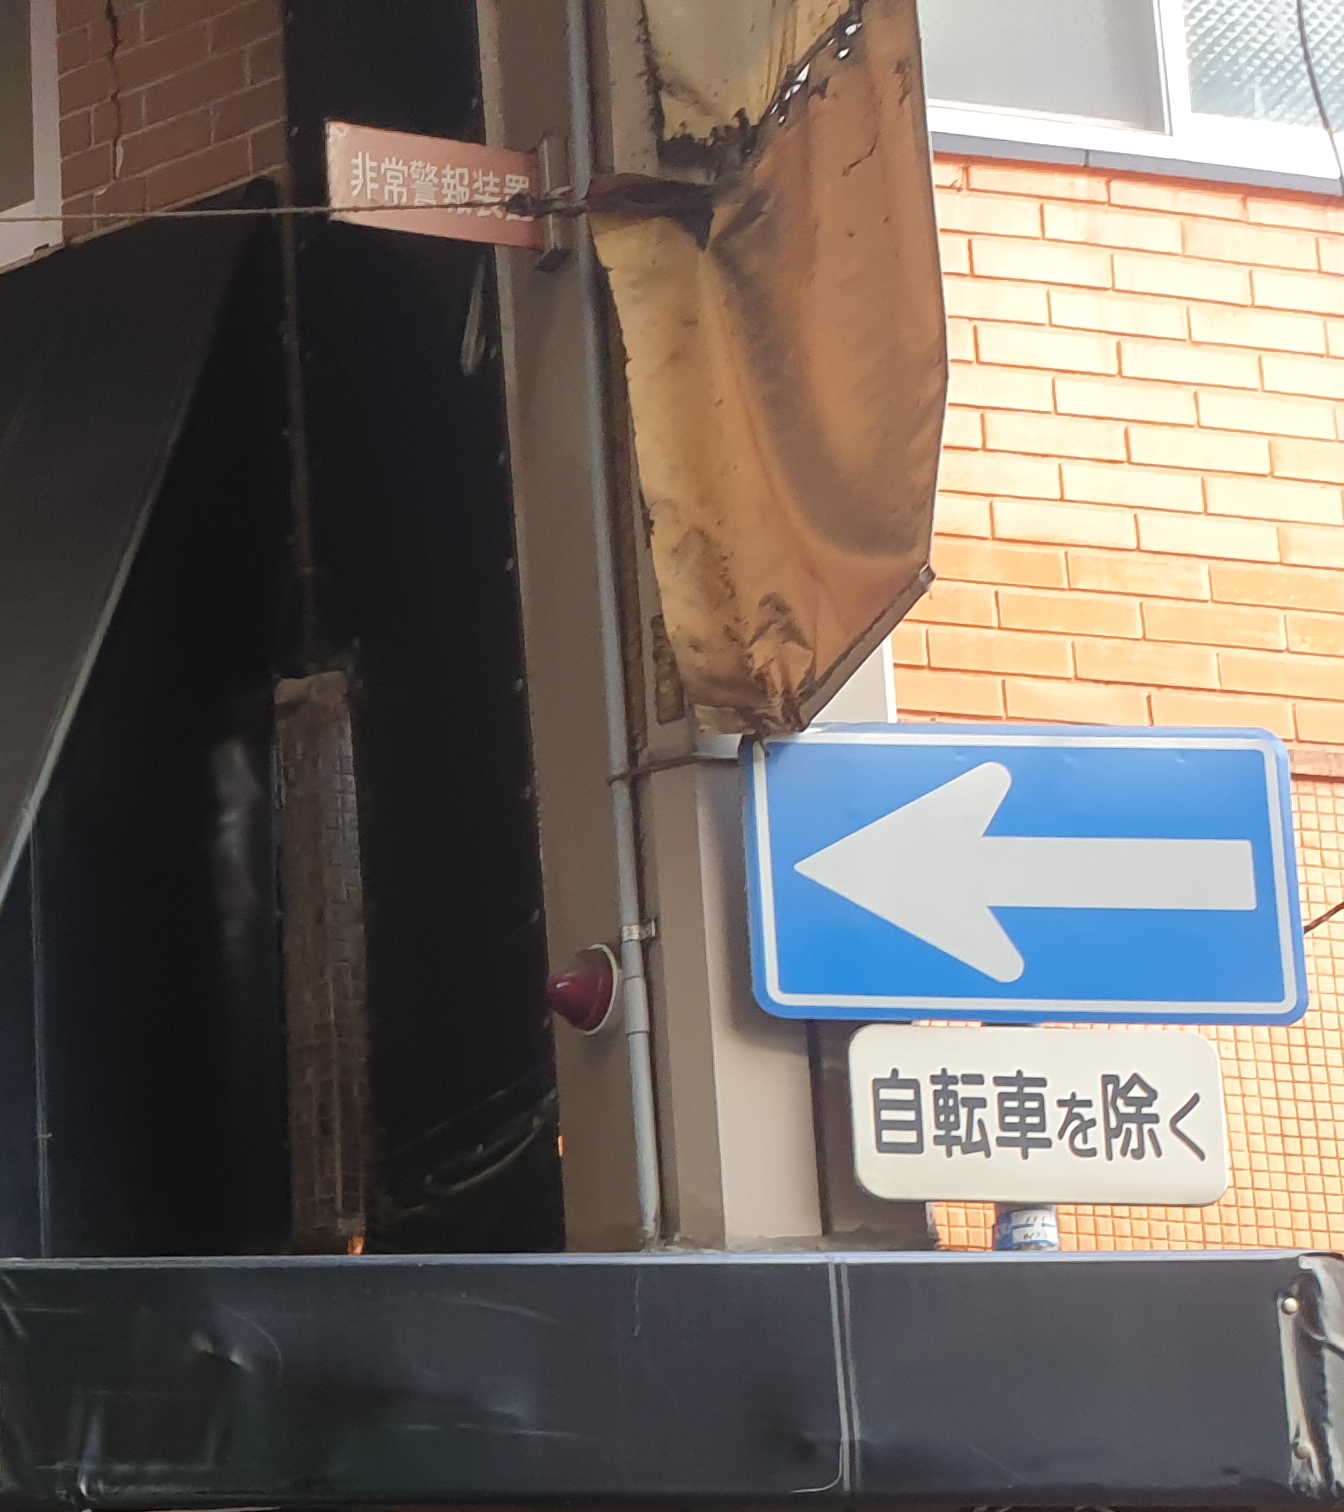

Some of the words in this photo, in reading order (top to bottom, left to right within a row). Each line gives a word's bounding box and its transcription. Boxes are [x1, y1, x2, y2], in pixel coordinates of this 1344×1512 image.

[869, 1066, 1207, 1165] 自転車を除く
